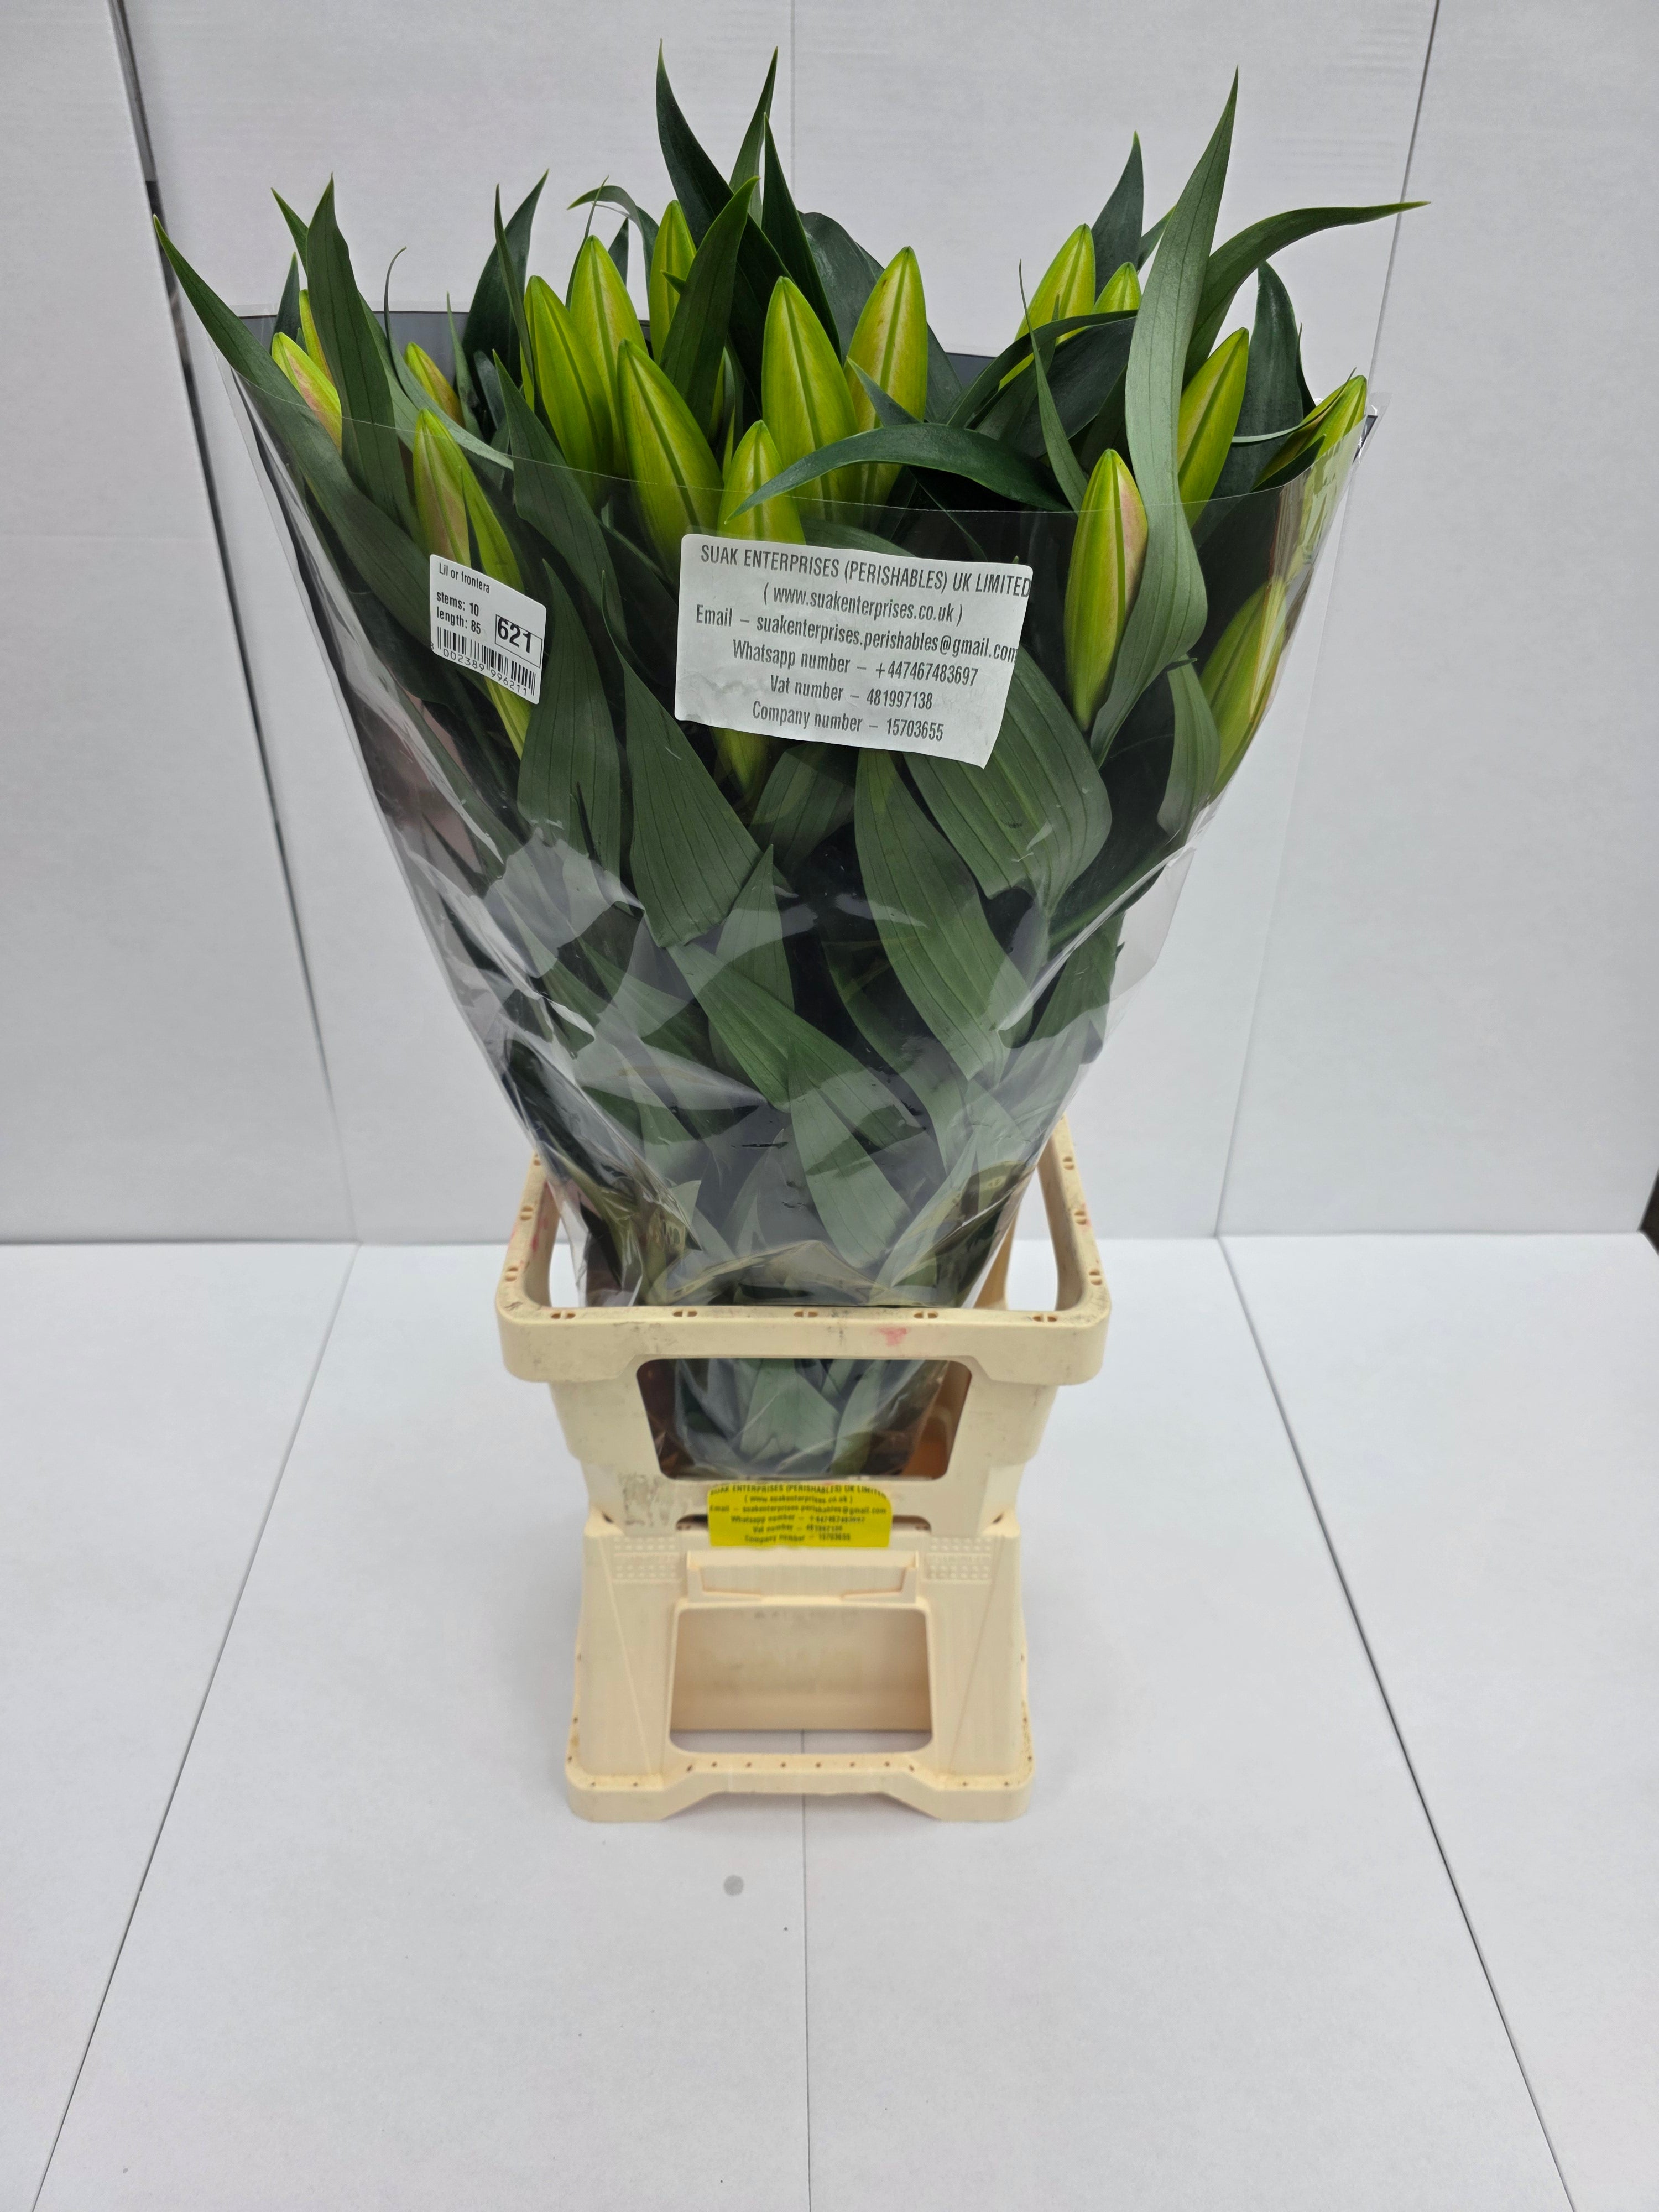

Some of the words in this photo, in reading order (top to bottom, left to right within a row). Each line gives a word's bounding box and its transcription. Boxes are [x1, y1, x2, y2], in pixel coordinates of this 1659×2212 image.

[439, 562, 448, 576] Lil
[451, 571, 458, 580] or
[461, 571, 490, 594] frontera
[701, 544, 738, 566] SUAK
[744, 549, 839, 578] ENTERPRISES
[844, 560, 947, 594] (PERISHABLES)
[952, 572, 972, 593] UK
[975, 573, 1031, 598] LIMITED
[436, 592, 466, 611] stems:
[469, 602, 479, 617] 10
[437, 606, 467, 629] length:
[471, 619, 481, 635] 85
[696, 604, 733, 628] Email
[497, 617, 532, 654] 621
[733, 639, 796, 669] Whatsapp
[801, 653, 851, 674] number
[875, 660, 979, 687] +447467483697
[770, 674, 790, 695] Vat
[794, 681, 844, 702] number
[866, 689, 933, 711] 481997138
[753, 701, 810, 729] Company
[814, 712, 863, 732] number
[886, 718, 944, 742] 15703655
